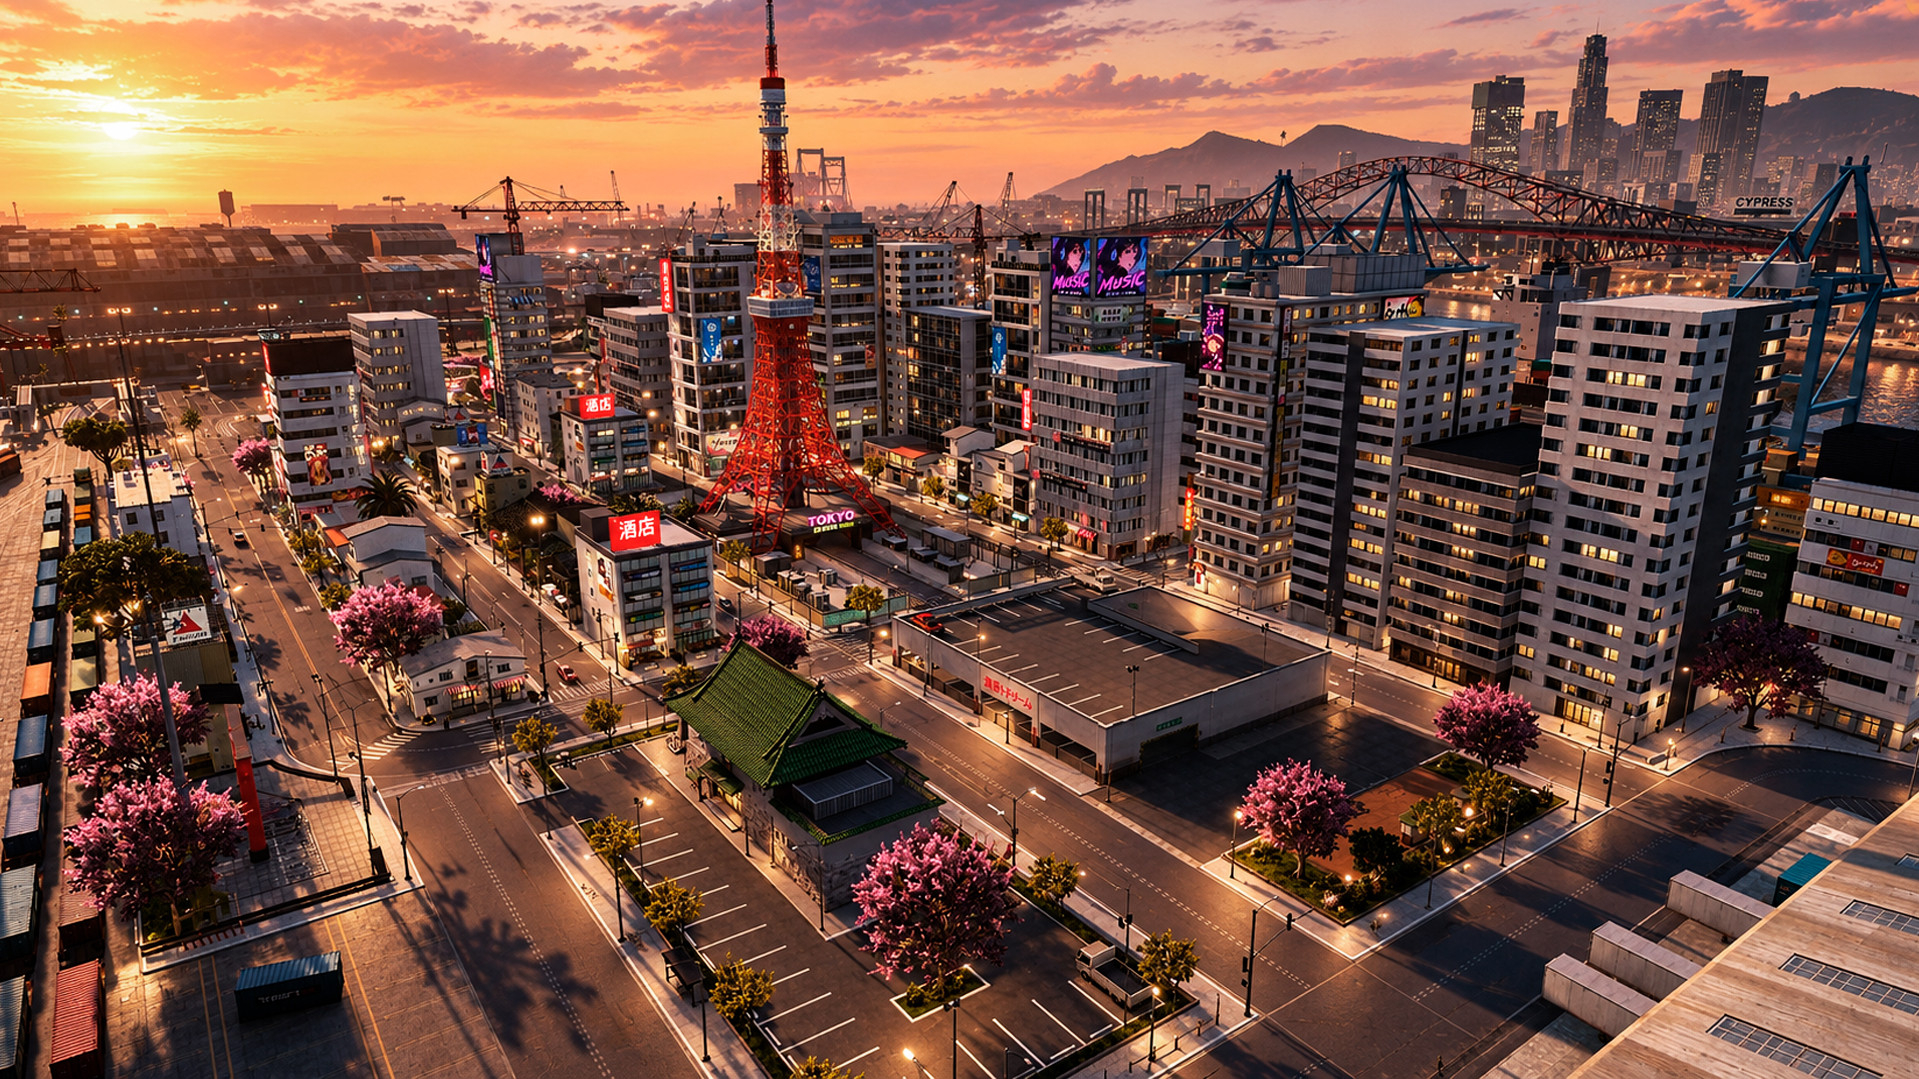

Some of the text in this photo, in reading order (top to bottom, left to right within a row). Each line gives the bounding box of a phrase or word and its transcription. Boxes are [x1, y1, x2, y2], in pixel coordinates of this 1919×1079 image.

[1735, 196, 1794, 207] CYPRESS
[1097, 271, 1145, 295] MUSIC
[619, 515, 655, 540] 酒店
[808, 510, 855, 527] TOKYO
